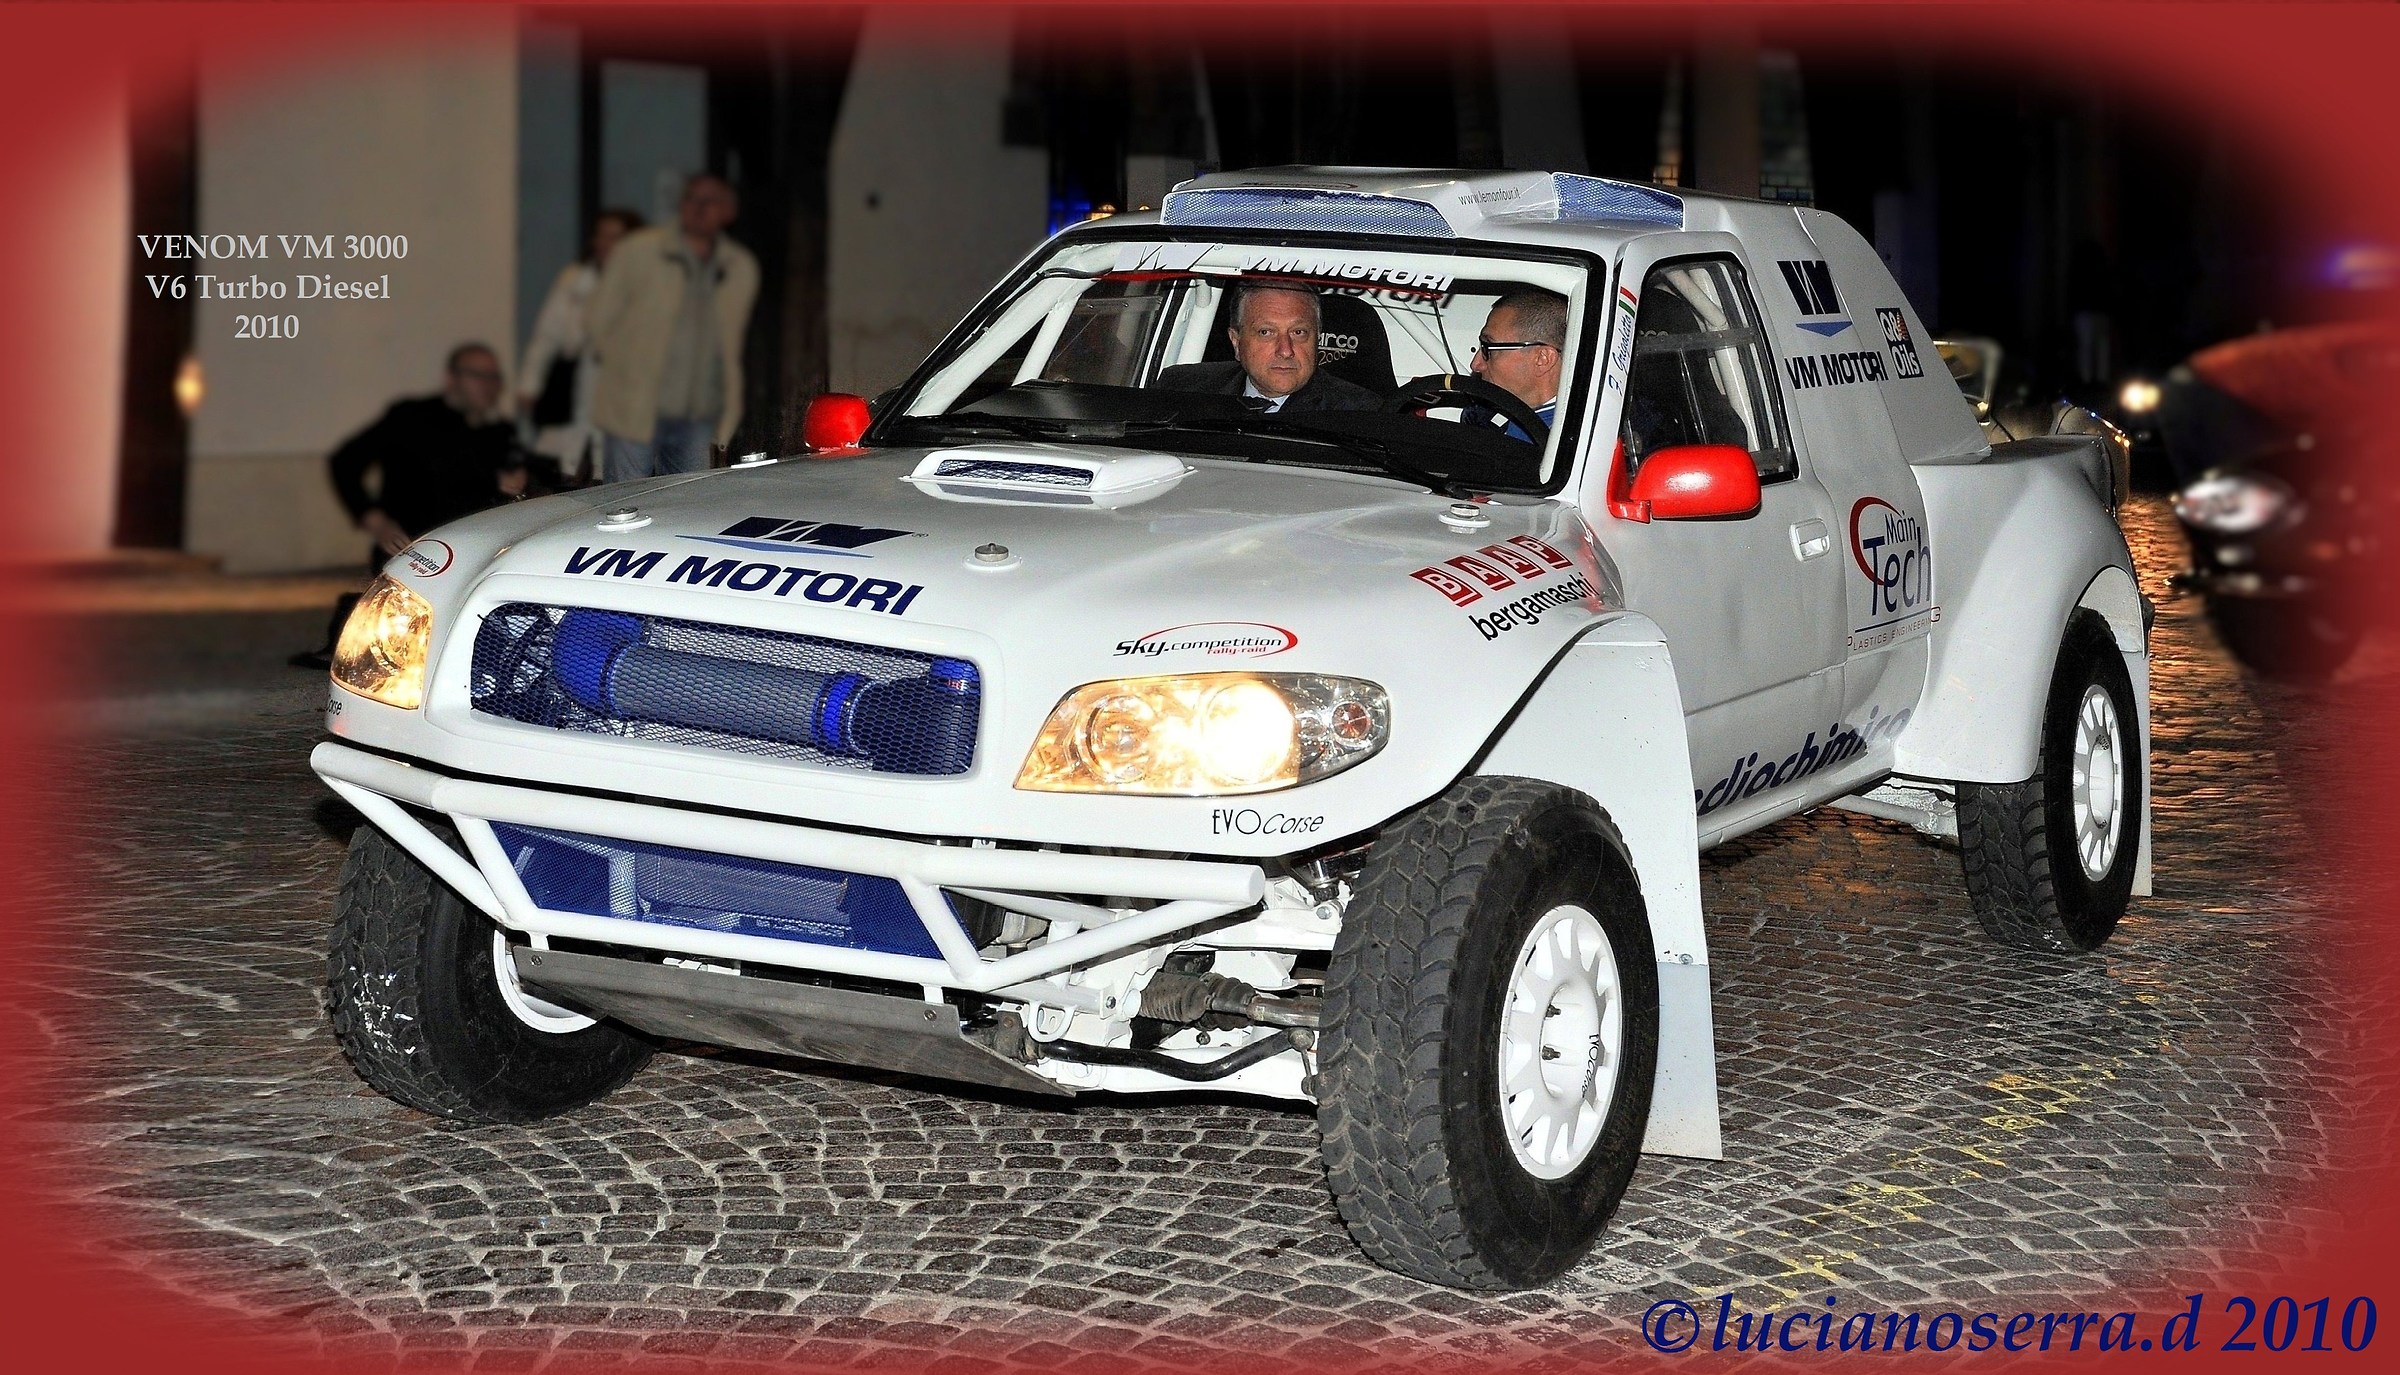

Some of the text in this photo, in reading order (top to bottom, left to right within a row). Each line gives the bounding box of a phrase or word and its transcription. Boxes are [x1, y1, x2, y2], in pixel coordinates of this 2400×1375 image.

[1303, 260, 1456, 291] MOTORI
[1784, 351, 1889, 390] VM MOTORI
[1891, 344, 1921, 376] Oils
[1884, 511, 1917, 546] Main
[564, 546, 925, 616] VM MOTORI
[1413, 536, 1564, 604] BAAP
[1863, 526, 1931, 616] Tech
[1468, 572, 1600, 641] bergamaschi
[1207, 646, 1267, 656] rally-raid
